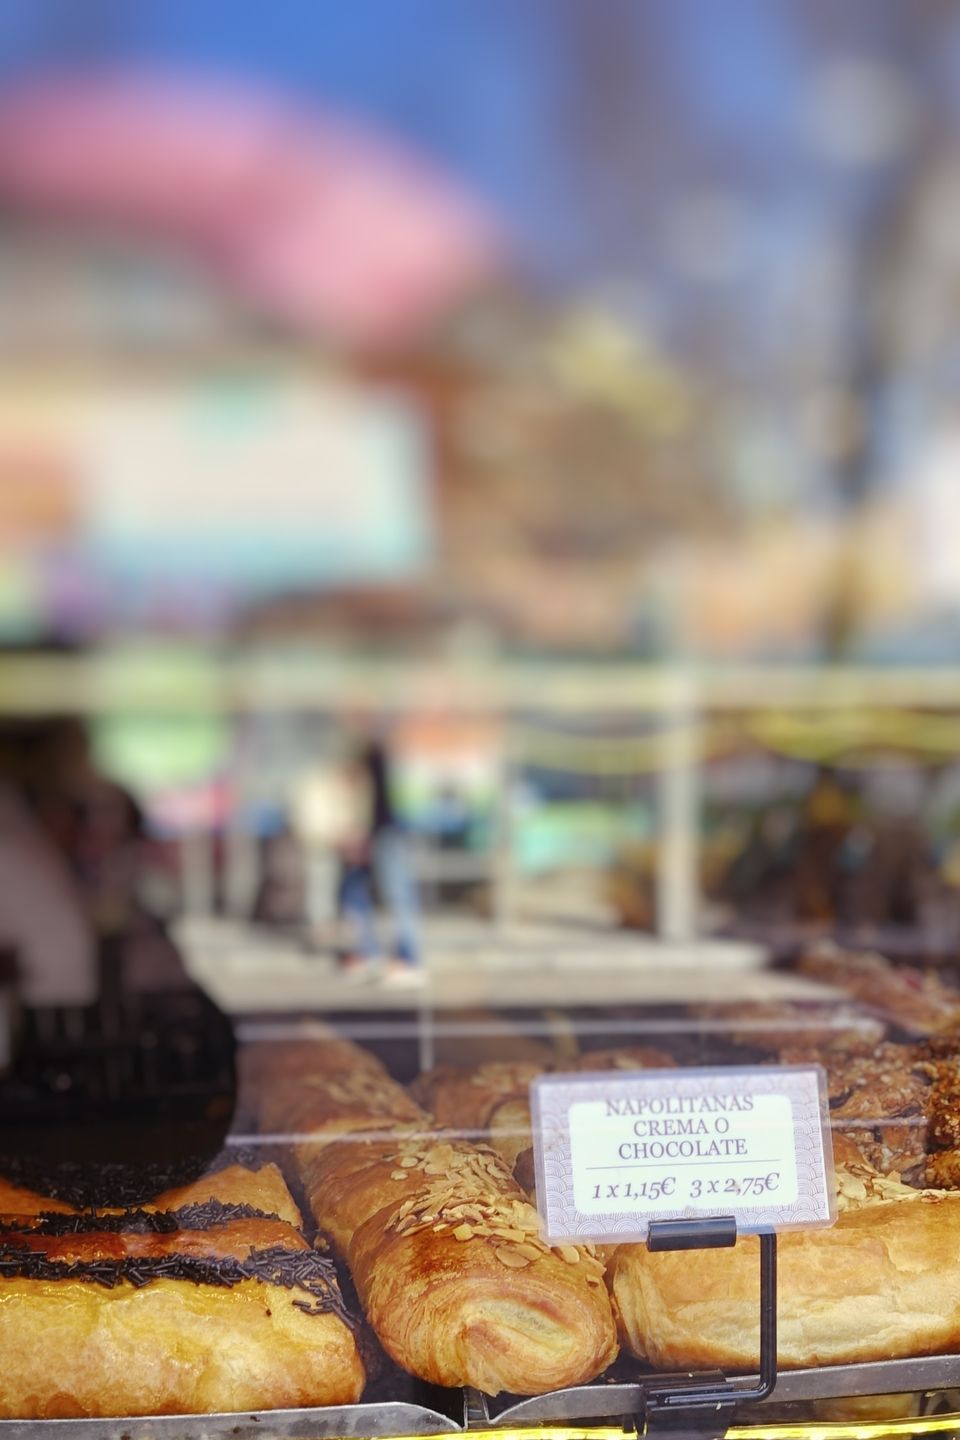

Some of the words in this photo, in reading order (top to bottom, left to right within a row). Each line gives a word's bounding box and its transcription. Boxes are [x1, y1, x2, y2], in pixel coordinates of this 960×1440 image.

[605, 1095, 754, 1117] NAPOLITANAS
[633, 1118, 709, 1137] CREMA
[715, 1117, 729, 1134] O
[619, 1138, 748, 1160] CHOCOLATE
[592, 1183, 601, 1199] 1
[606, 1184, 619, 1198] x
[623, 1176, 677, 1201] 1,15€
[690, 1180, 702, 1198] 3
[707, 1180, 720, 1193] x
[724, 1172, 780, 1197] 2,75€
